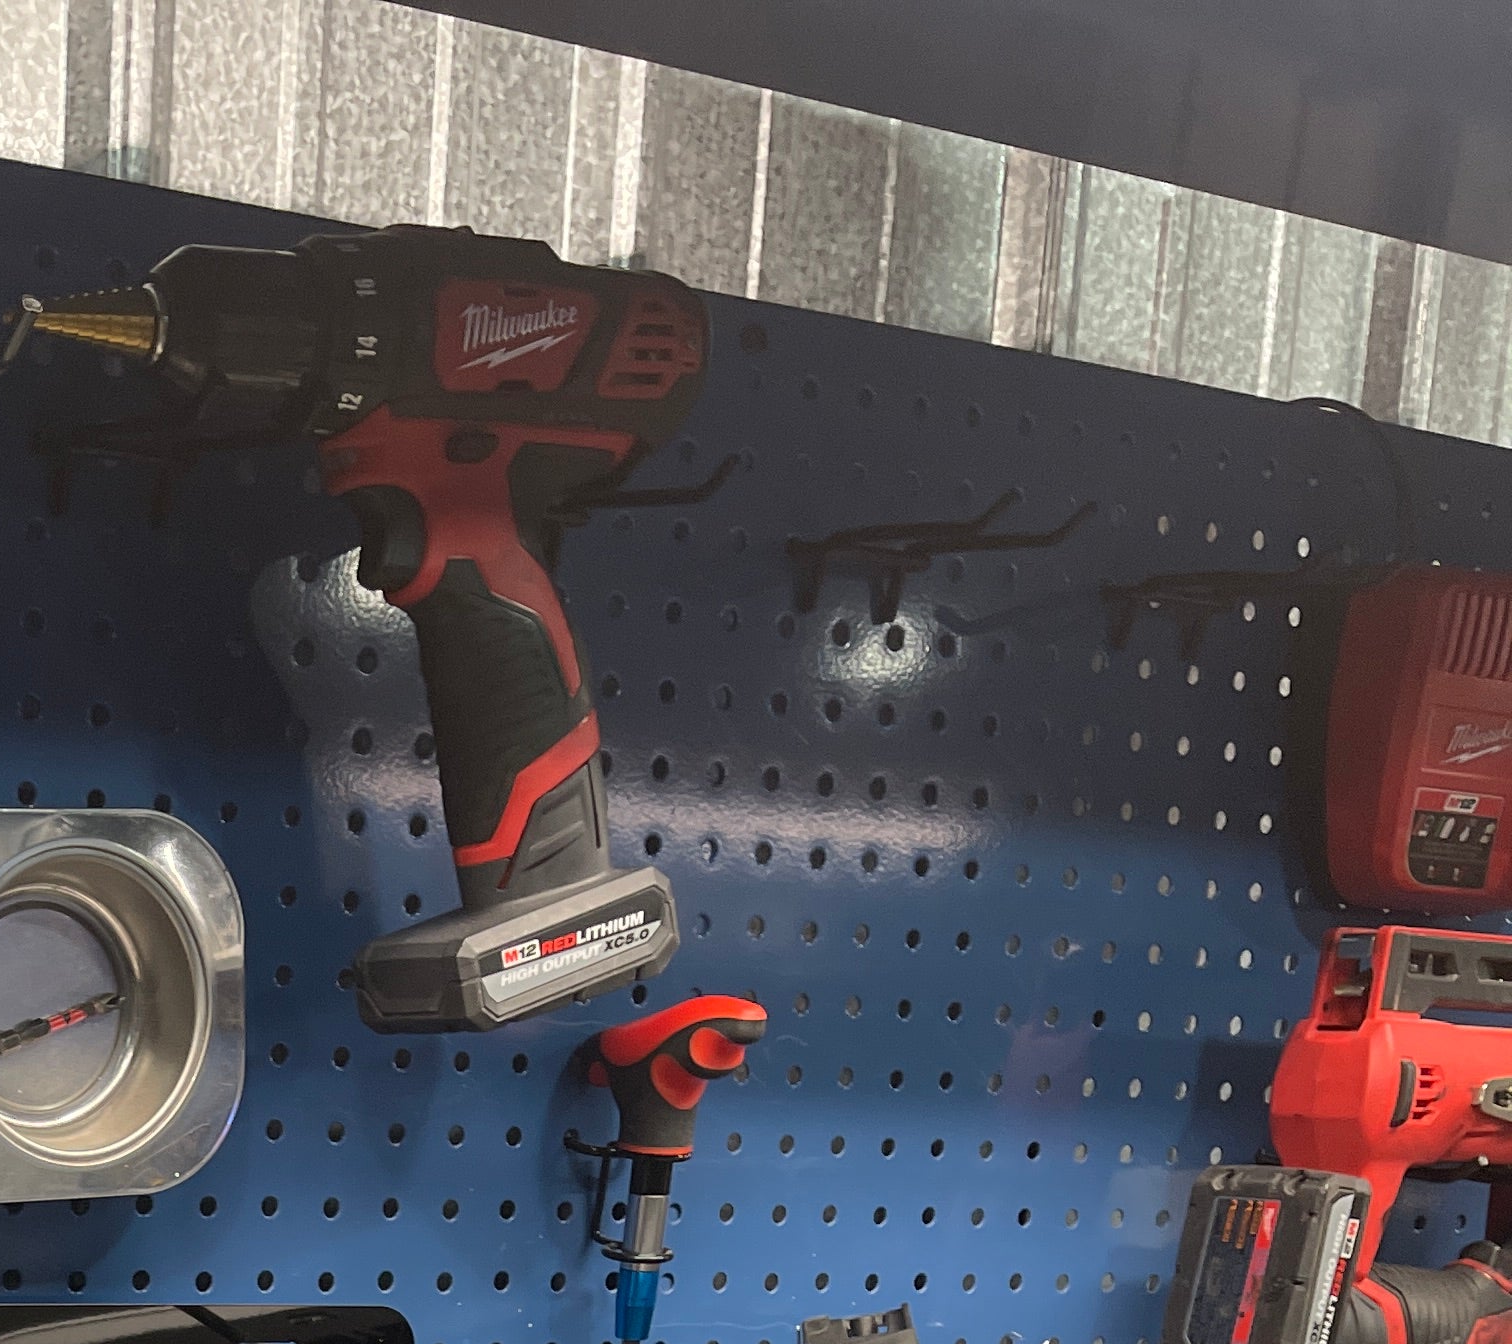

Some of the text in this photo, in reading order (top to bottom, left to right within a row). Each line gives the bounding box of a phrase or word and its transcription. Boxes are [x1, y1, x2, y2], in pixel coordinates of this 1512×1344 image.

[460, 301, 578, 353] Milwaukee
[355, 335, 379, 359] 14
[338, 392, 364, 411] 12
[500, 928, 650, 987] HIGH OUTPUT XC5.0
[503, 943, 538, 965] M12
